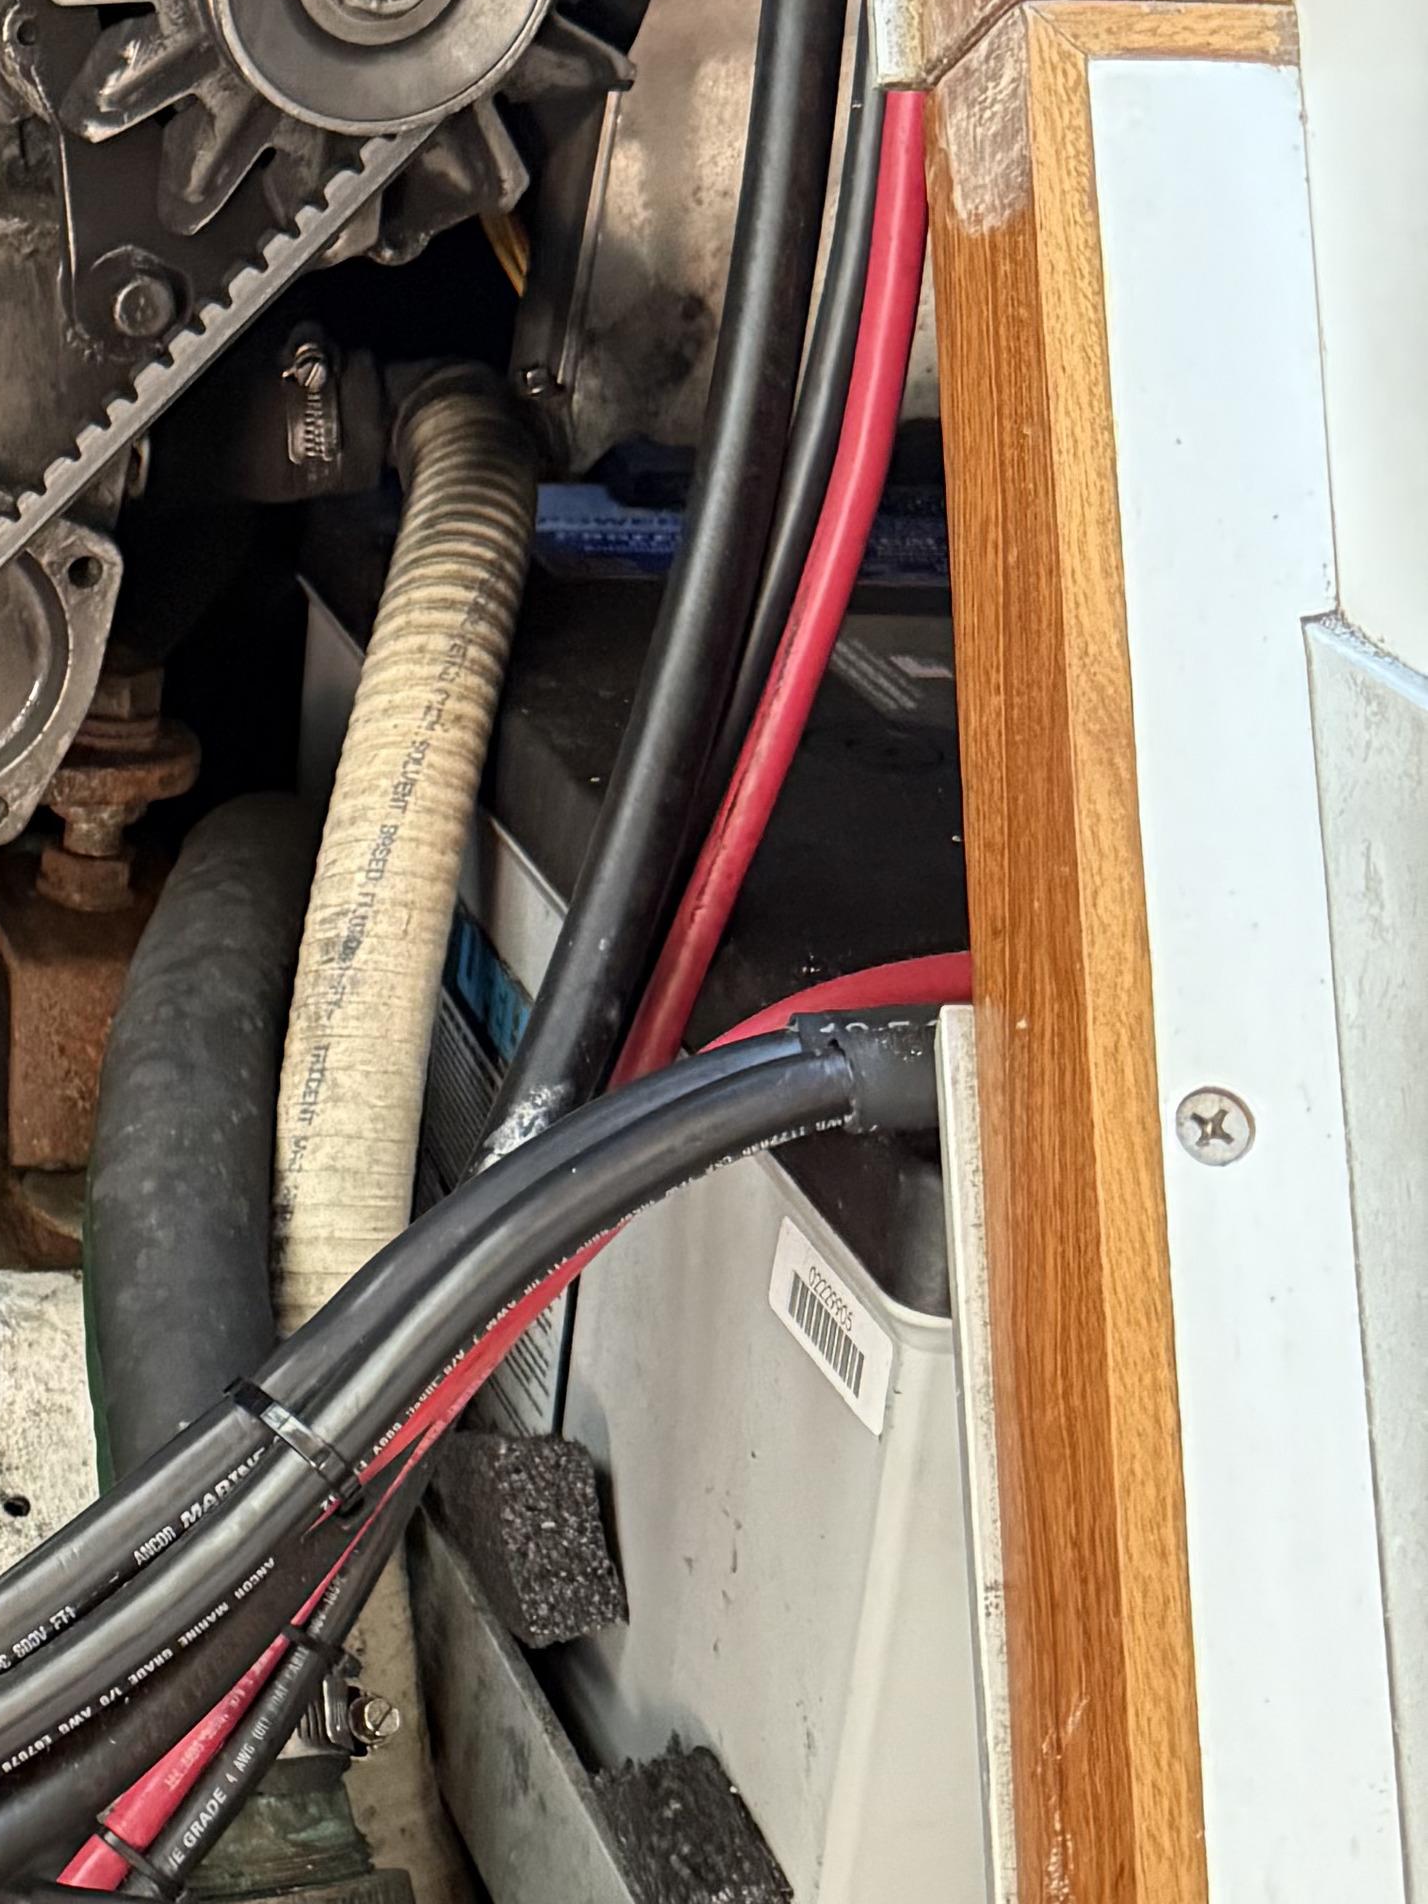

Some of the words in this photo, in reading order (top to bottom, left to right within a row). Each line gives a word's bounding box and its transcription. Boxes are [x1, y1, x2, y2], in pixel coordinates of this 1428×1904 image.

[297, 1043, 330, 1127] TRIDENT
[133, 1525, 177, 1567] ANCOR
[235, 1556, 275, 1600] ANCOR
[178, 1602, 230, 1649] MARINE
[128, 1648, 174, 1685] GRADE
[58, 1708, 93, 1737] AWG
[183, 1787, 227, 1848] GRADE
[233, 1743, 257, 1772] AWG
